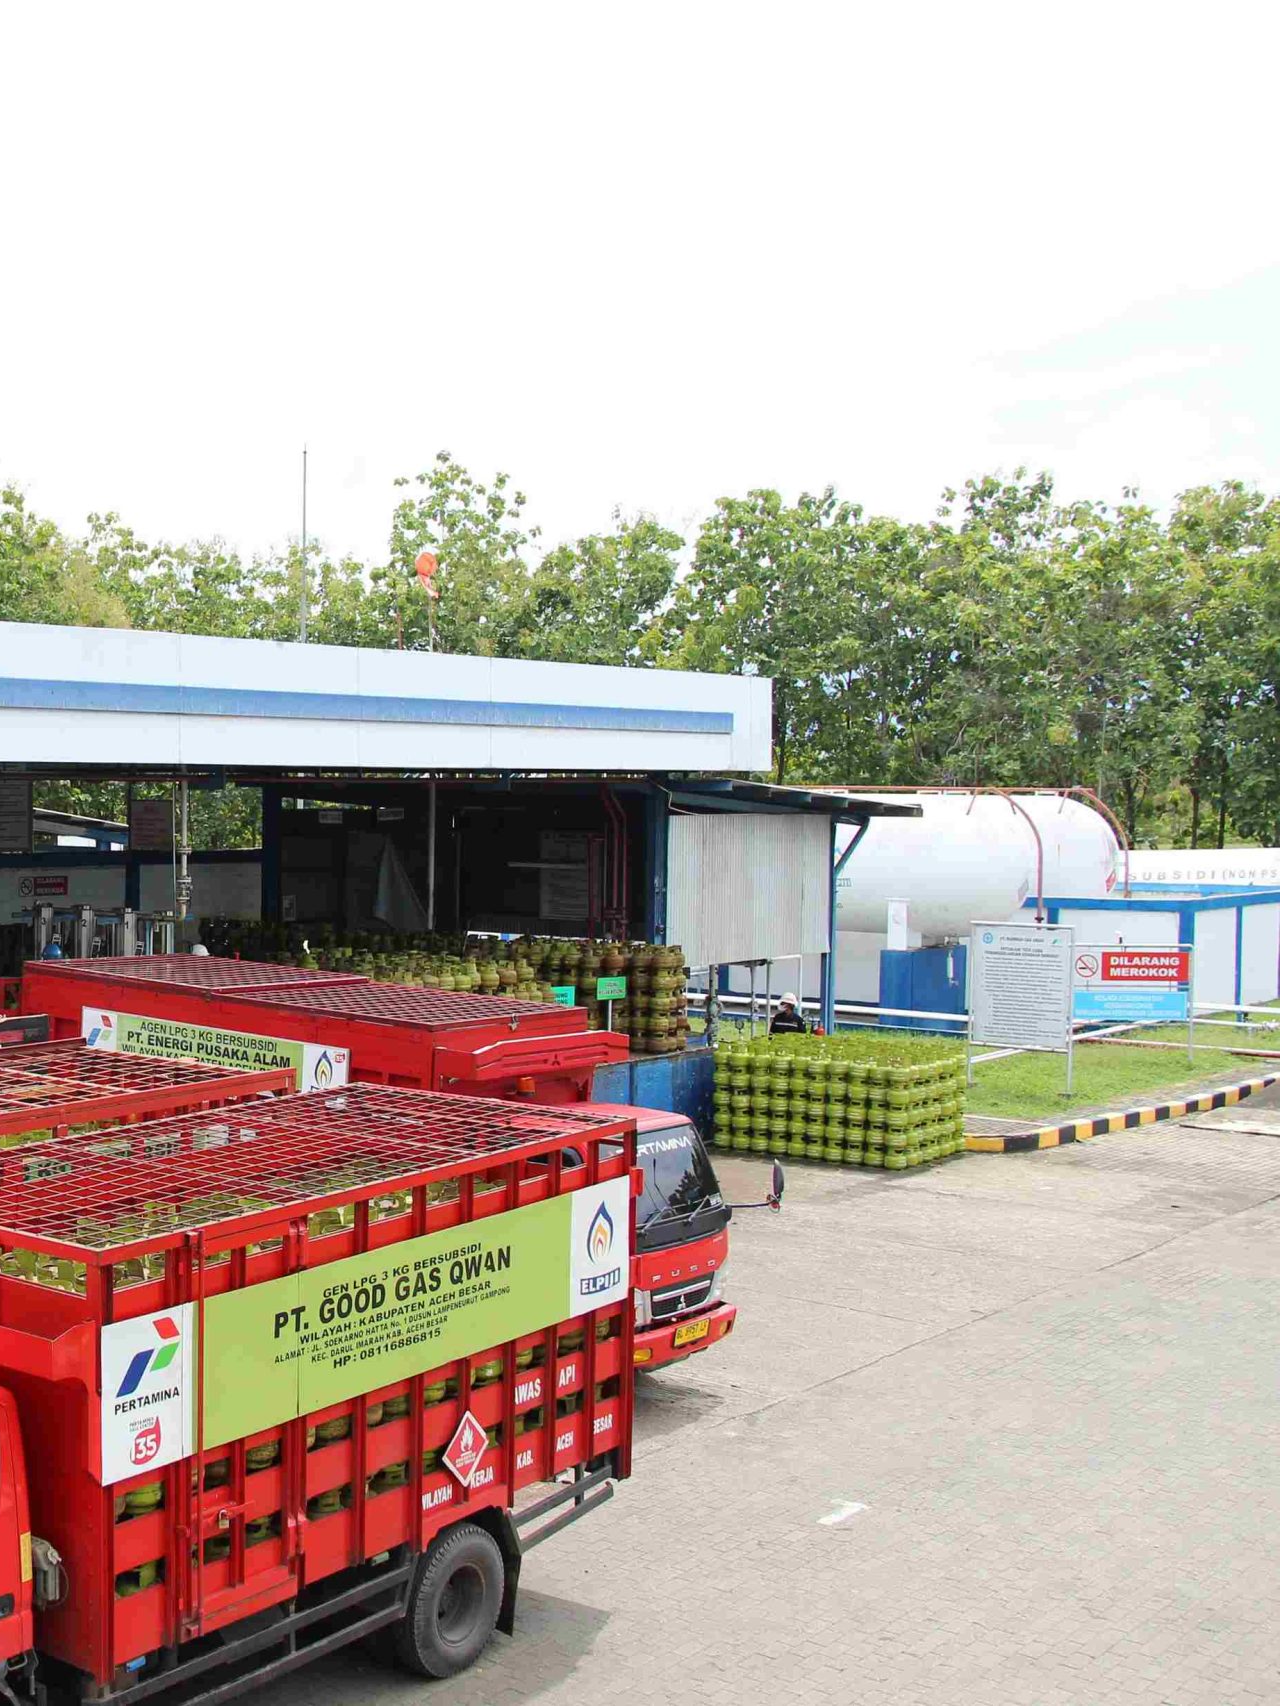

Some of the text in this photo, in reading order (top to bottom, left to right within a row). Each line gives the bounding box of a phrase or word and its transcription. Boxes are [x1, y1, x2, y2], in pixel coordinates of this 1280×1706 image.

[1110, 957, 1180, 966] DILARANG
[1110, 968, 1178, 977] MEROKOK
[127, 1031, 291, 1068] PT. ENERGI PUSAKA ALAM
[140, 1021, 277, 1053] AGEN LPG 3 KG BERSUBSIDI
[323, 1242, 481, 1298] GEN LPG 3 KG BERSUBSIDI
[581, 1267, 620, 1294] ELPIJI
[652, 1260, 716, 1282] FUSO
[273, 1245, 511, 1339] PT. GOOD GAS QWAN
[359, 1301, 425, 1327] KABUPATEN
[429, 1291, 456, 1307] ACEH
[458, 1280, 491, 1298] BESAR
[311, 1344, 322, 1353] JL.
[324, 1330, 364, 1349] SOEKARNO
[365, 1321, 388, 1335] HATTA
[408, 1309, 432, 1323] DUSUN
[433, 1296, 478, 1316] LAMPENEURUT
[480, 1286, 511, 1301] GAMPONG
[311, 1315, 448, 1364] KEC. DARUL IMARAH KAB. ACEH BESAR
[359, 1327, 441, 1360] 08116886815
[558, 1364, 576, 1388] API
[114, 1386, 180, 1416] PERTAMINA
[471, 1466, 494, 1489] KERJA
[516, 1450, 534, 1470] KAB.
[556, 1431, 574, 1452] ACEH
